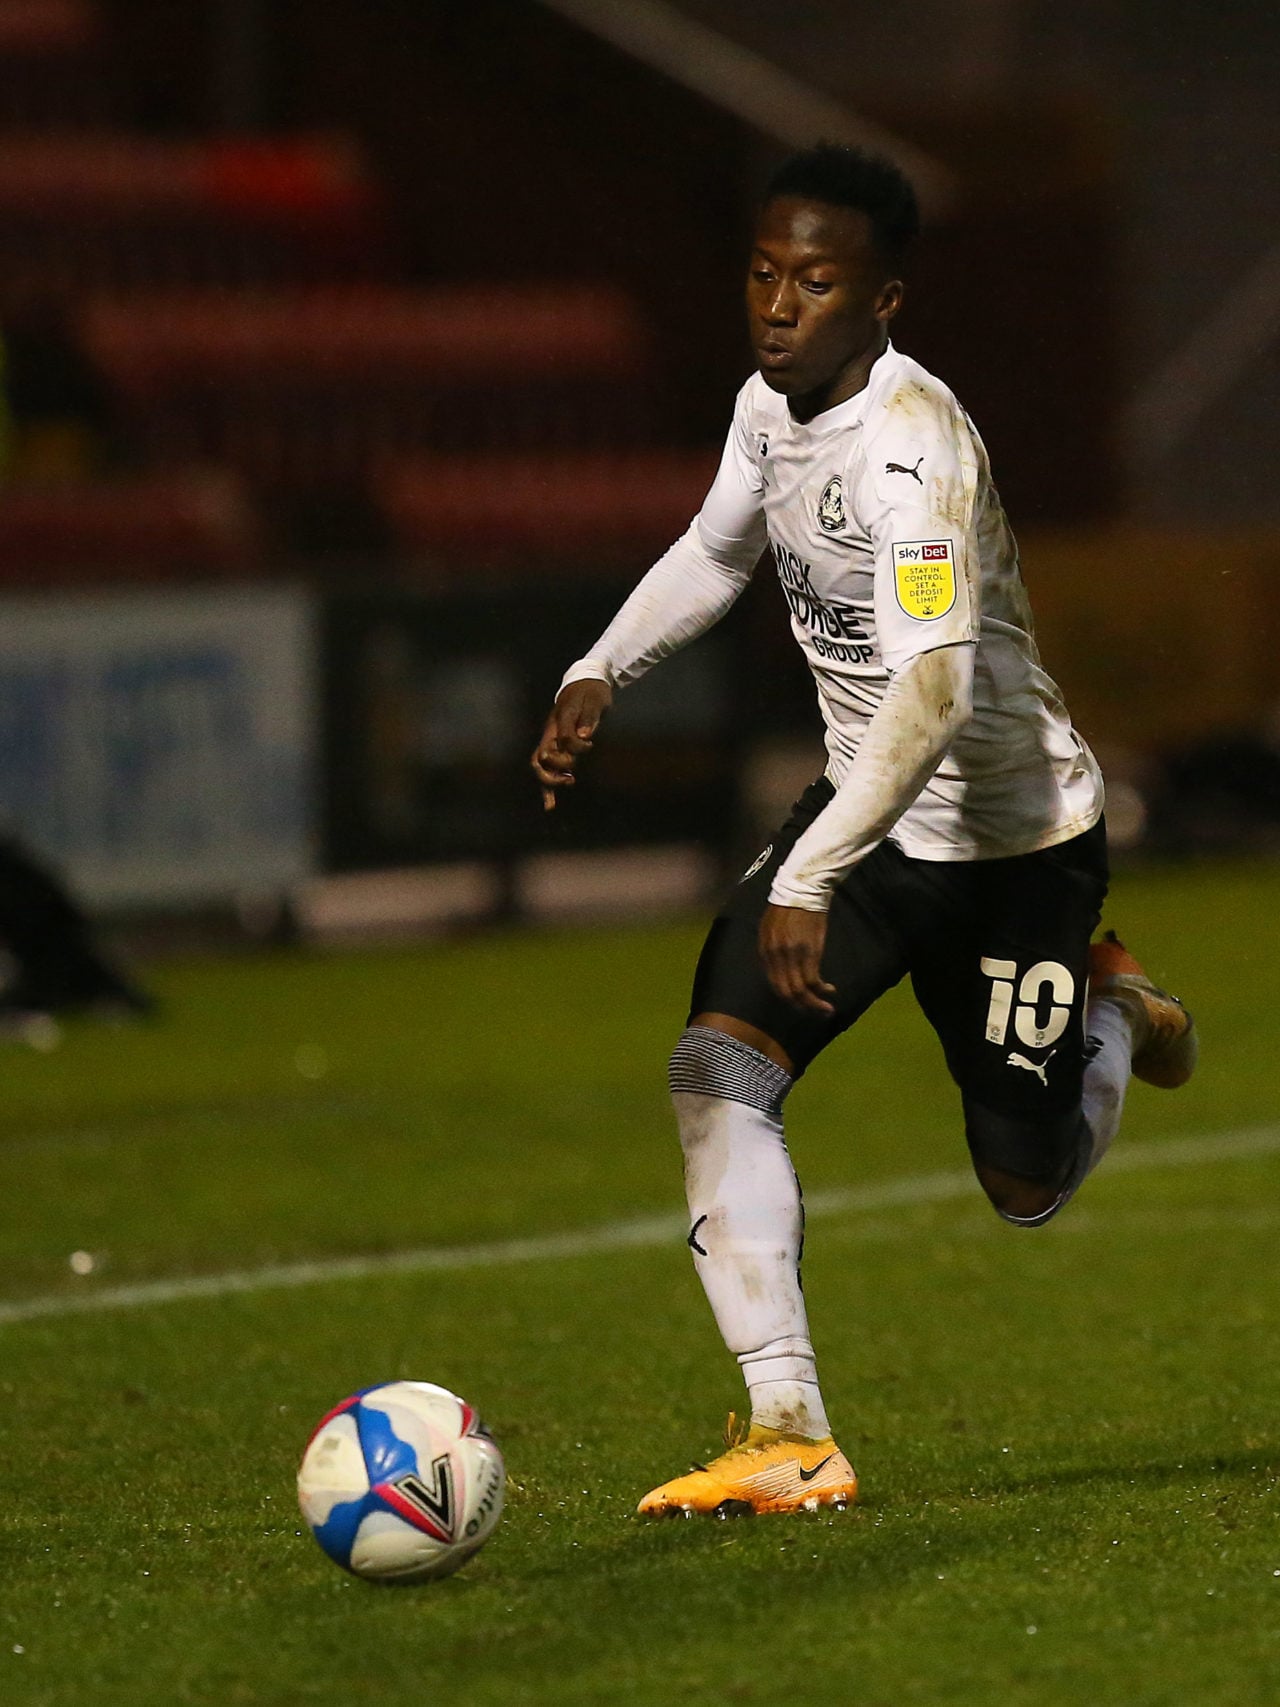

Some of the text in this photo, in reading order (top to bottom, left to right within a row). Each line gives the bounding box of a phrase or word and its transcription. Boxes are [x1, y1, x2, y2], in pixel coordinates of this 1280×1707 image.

[898, 546, 947, 560] sky bet
[910, 567, 928, 575] STAY
[904, 573, 946, 582] CONTROL.
[915, 581, 929, 589] SET
[909, 588, 943, 597] DEPOSIT
[916, 595, 938, 604] LIMIT
[811, 635, 874, 664] GROUP
[979, 956, 1075, 1048] 10
